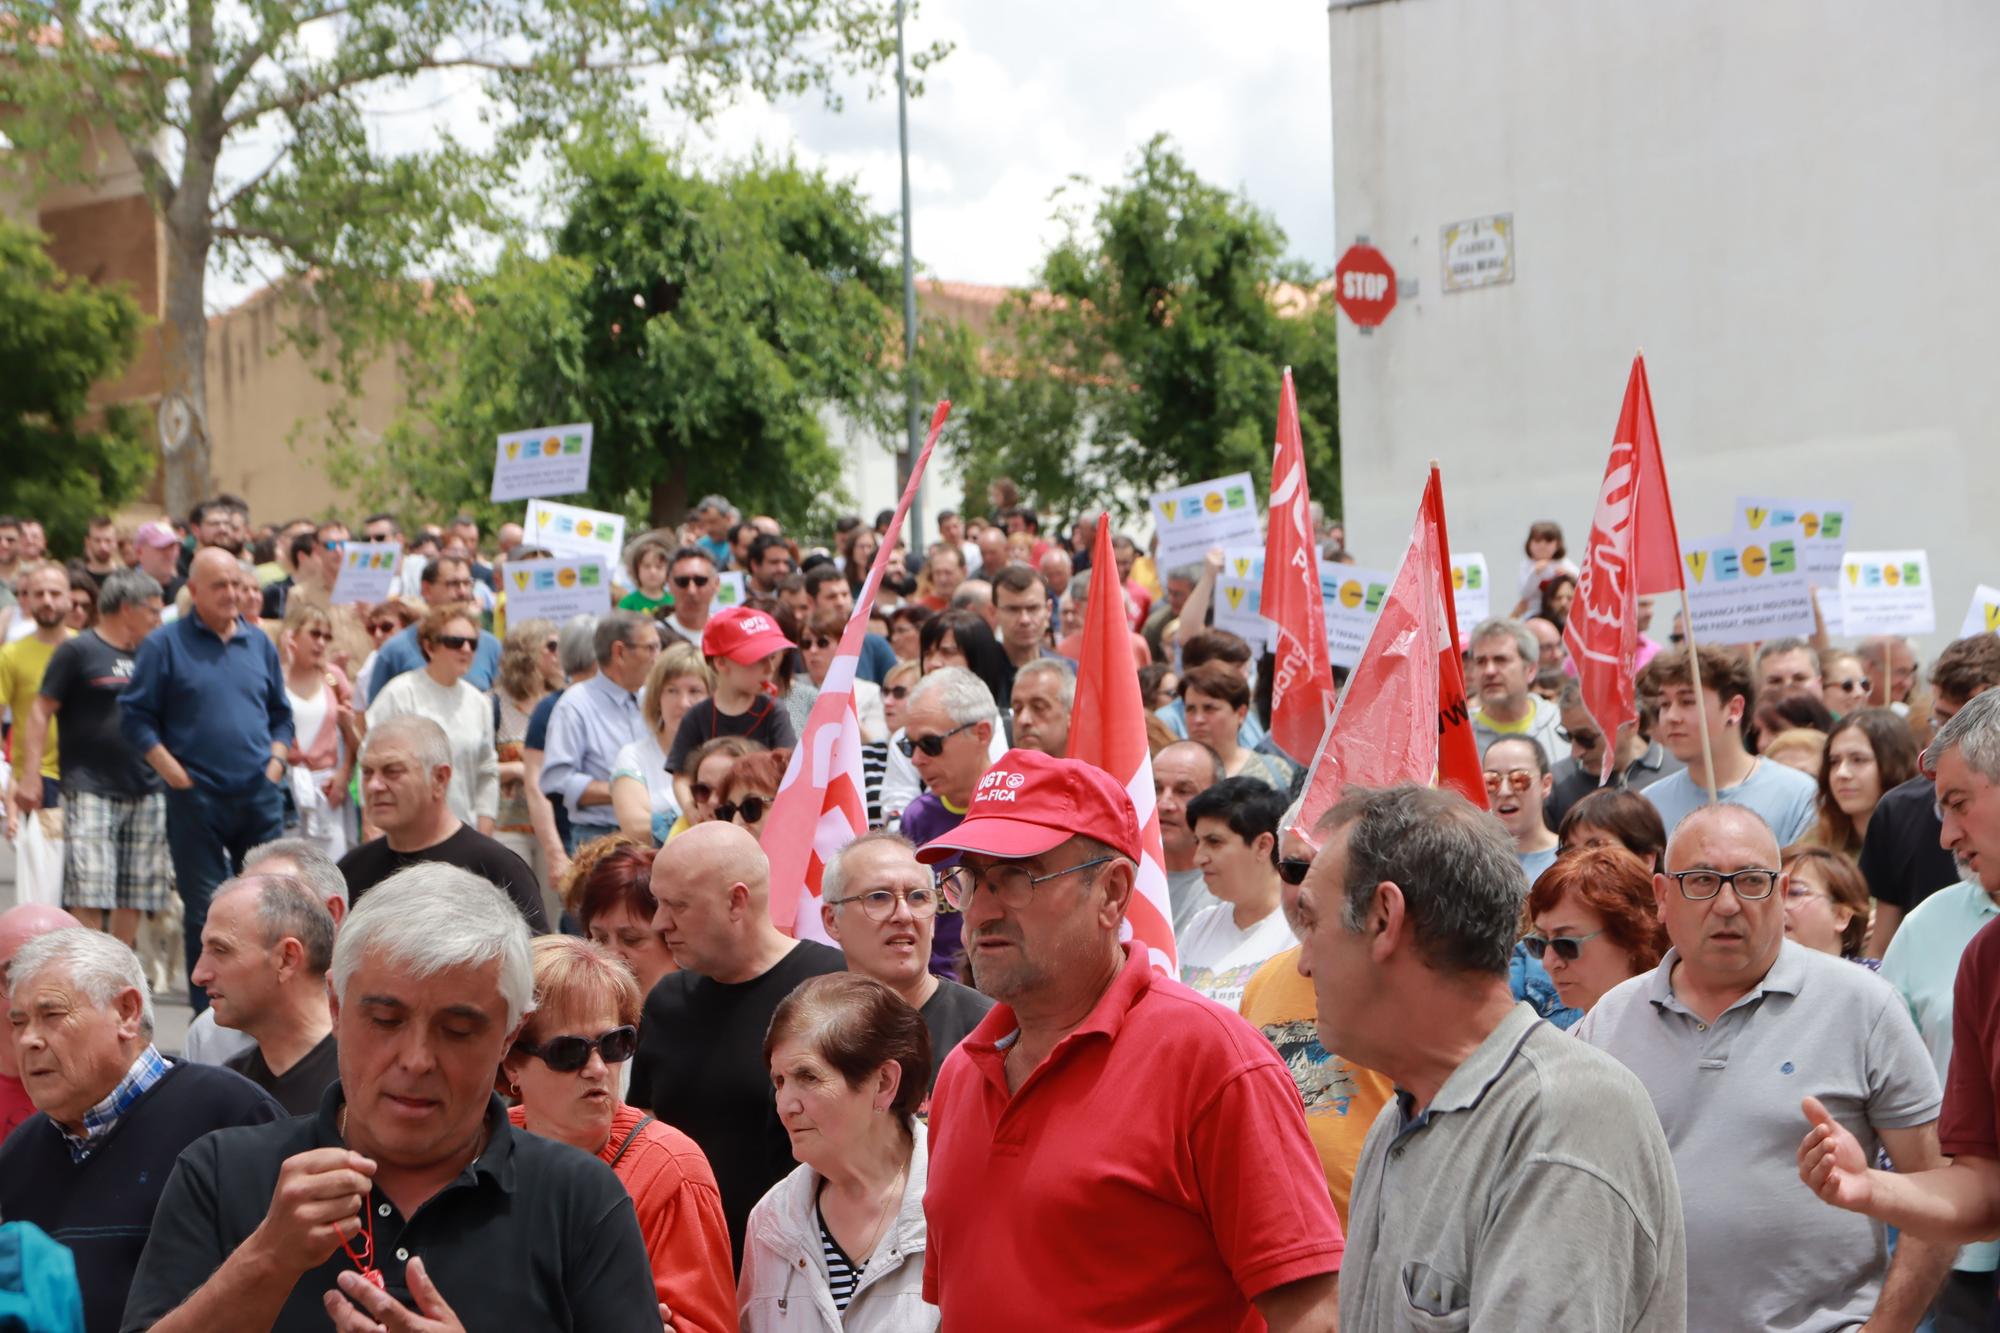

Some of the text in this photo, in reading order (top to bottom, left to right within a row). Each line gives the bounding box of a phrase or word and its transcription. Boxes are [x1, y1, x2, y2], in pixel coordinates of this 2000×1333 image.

[1343, 270, 1389, 302] STOP
[977, 770, 1008, 792] UGT
[988, 788, 1016, 803] FICA
